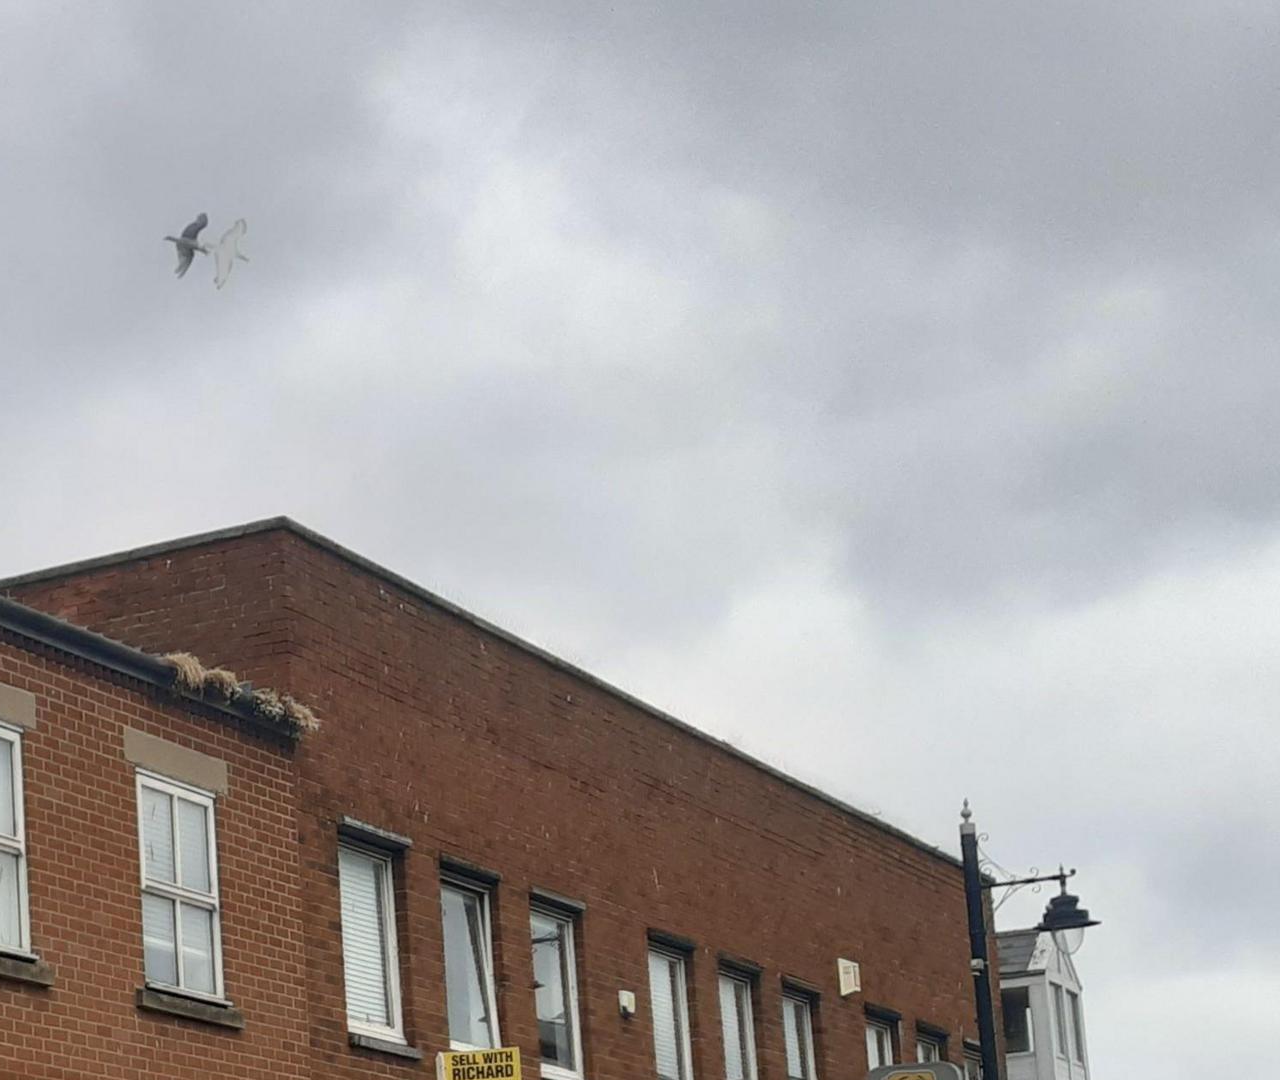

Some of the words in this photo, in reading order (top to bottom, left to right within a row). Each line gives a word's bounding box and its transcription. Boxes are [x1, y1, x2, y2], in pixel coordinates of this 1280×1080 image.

[451, 1054, 479, 1067] SELL
[482, 1051, 513, 1064] WITH
[452, 1064, 514, 1080] RICHARD
